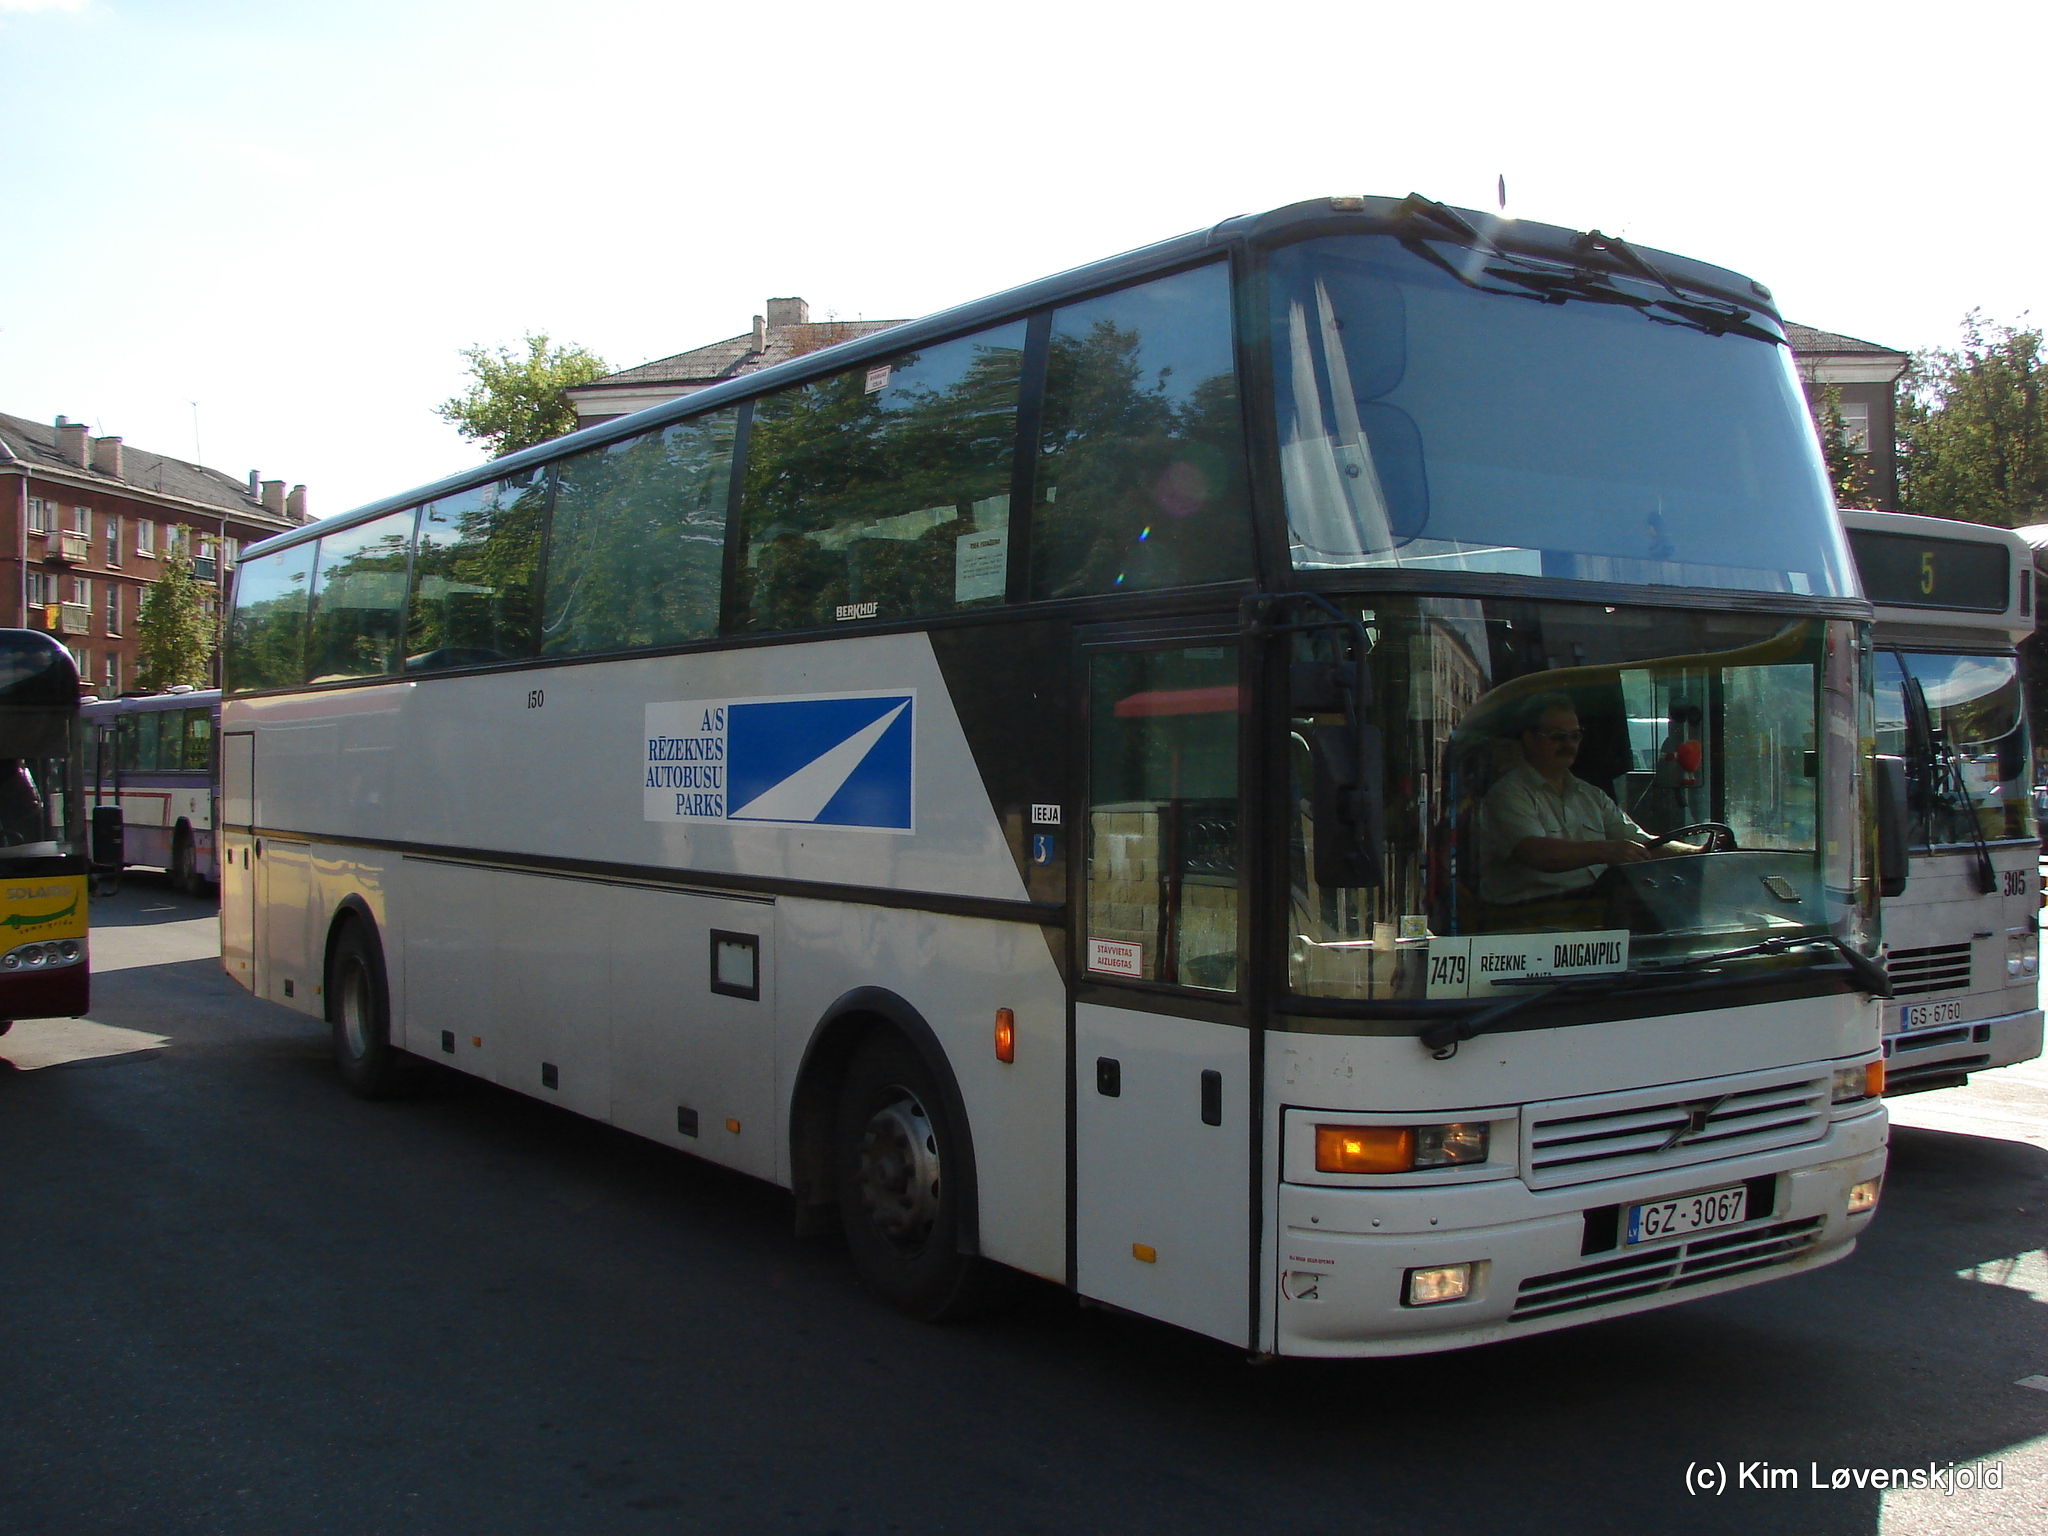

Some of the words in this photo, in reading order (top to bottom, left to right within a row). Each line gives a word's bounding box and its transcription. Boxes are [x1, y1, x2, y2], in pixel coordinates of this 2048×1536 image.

[1921, 552, 1934, 594] 5
[836, 602, 878, 621] BERKHOF
[528, 690, 544, 708] 150
[701, 708, 724, 733] A/S
[648, 736, 723, 761] RĒZEKNES
[646, 766, 723, 789] AUTOBUSU
[676, 793, 723, 817] PARKS
[1033, 806, 1059, 822] IEEJA
[2004, 871, 2025, 896] 305
[1097, 957, 1132, 968] AIZLIEGTAS
[1431, 956, 1466, 985] 7479
[1481, 953, 1527, 972] RĒZEKNE
[1553, 941, 1621, 968] DAUGAVPILS
[1910, 1002, 1960, 1025] GS-6760
[1628, 1228, 1638, 1238] LV
[1645, 1191, 1743, 1235] GZ-3067
